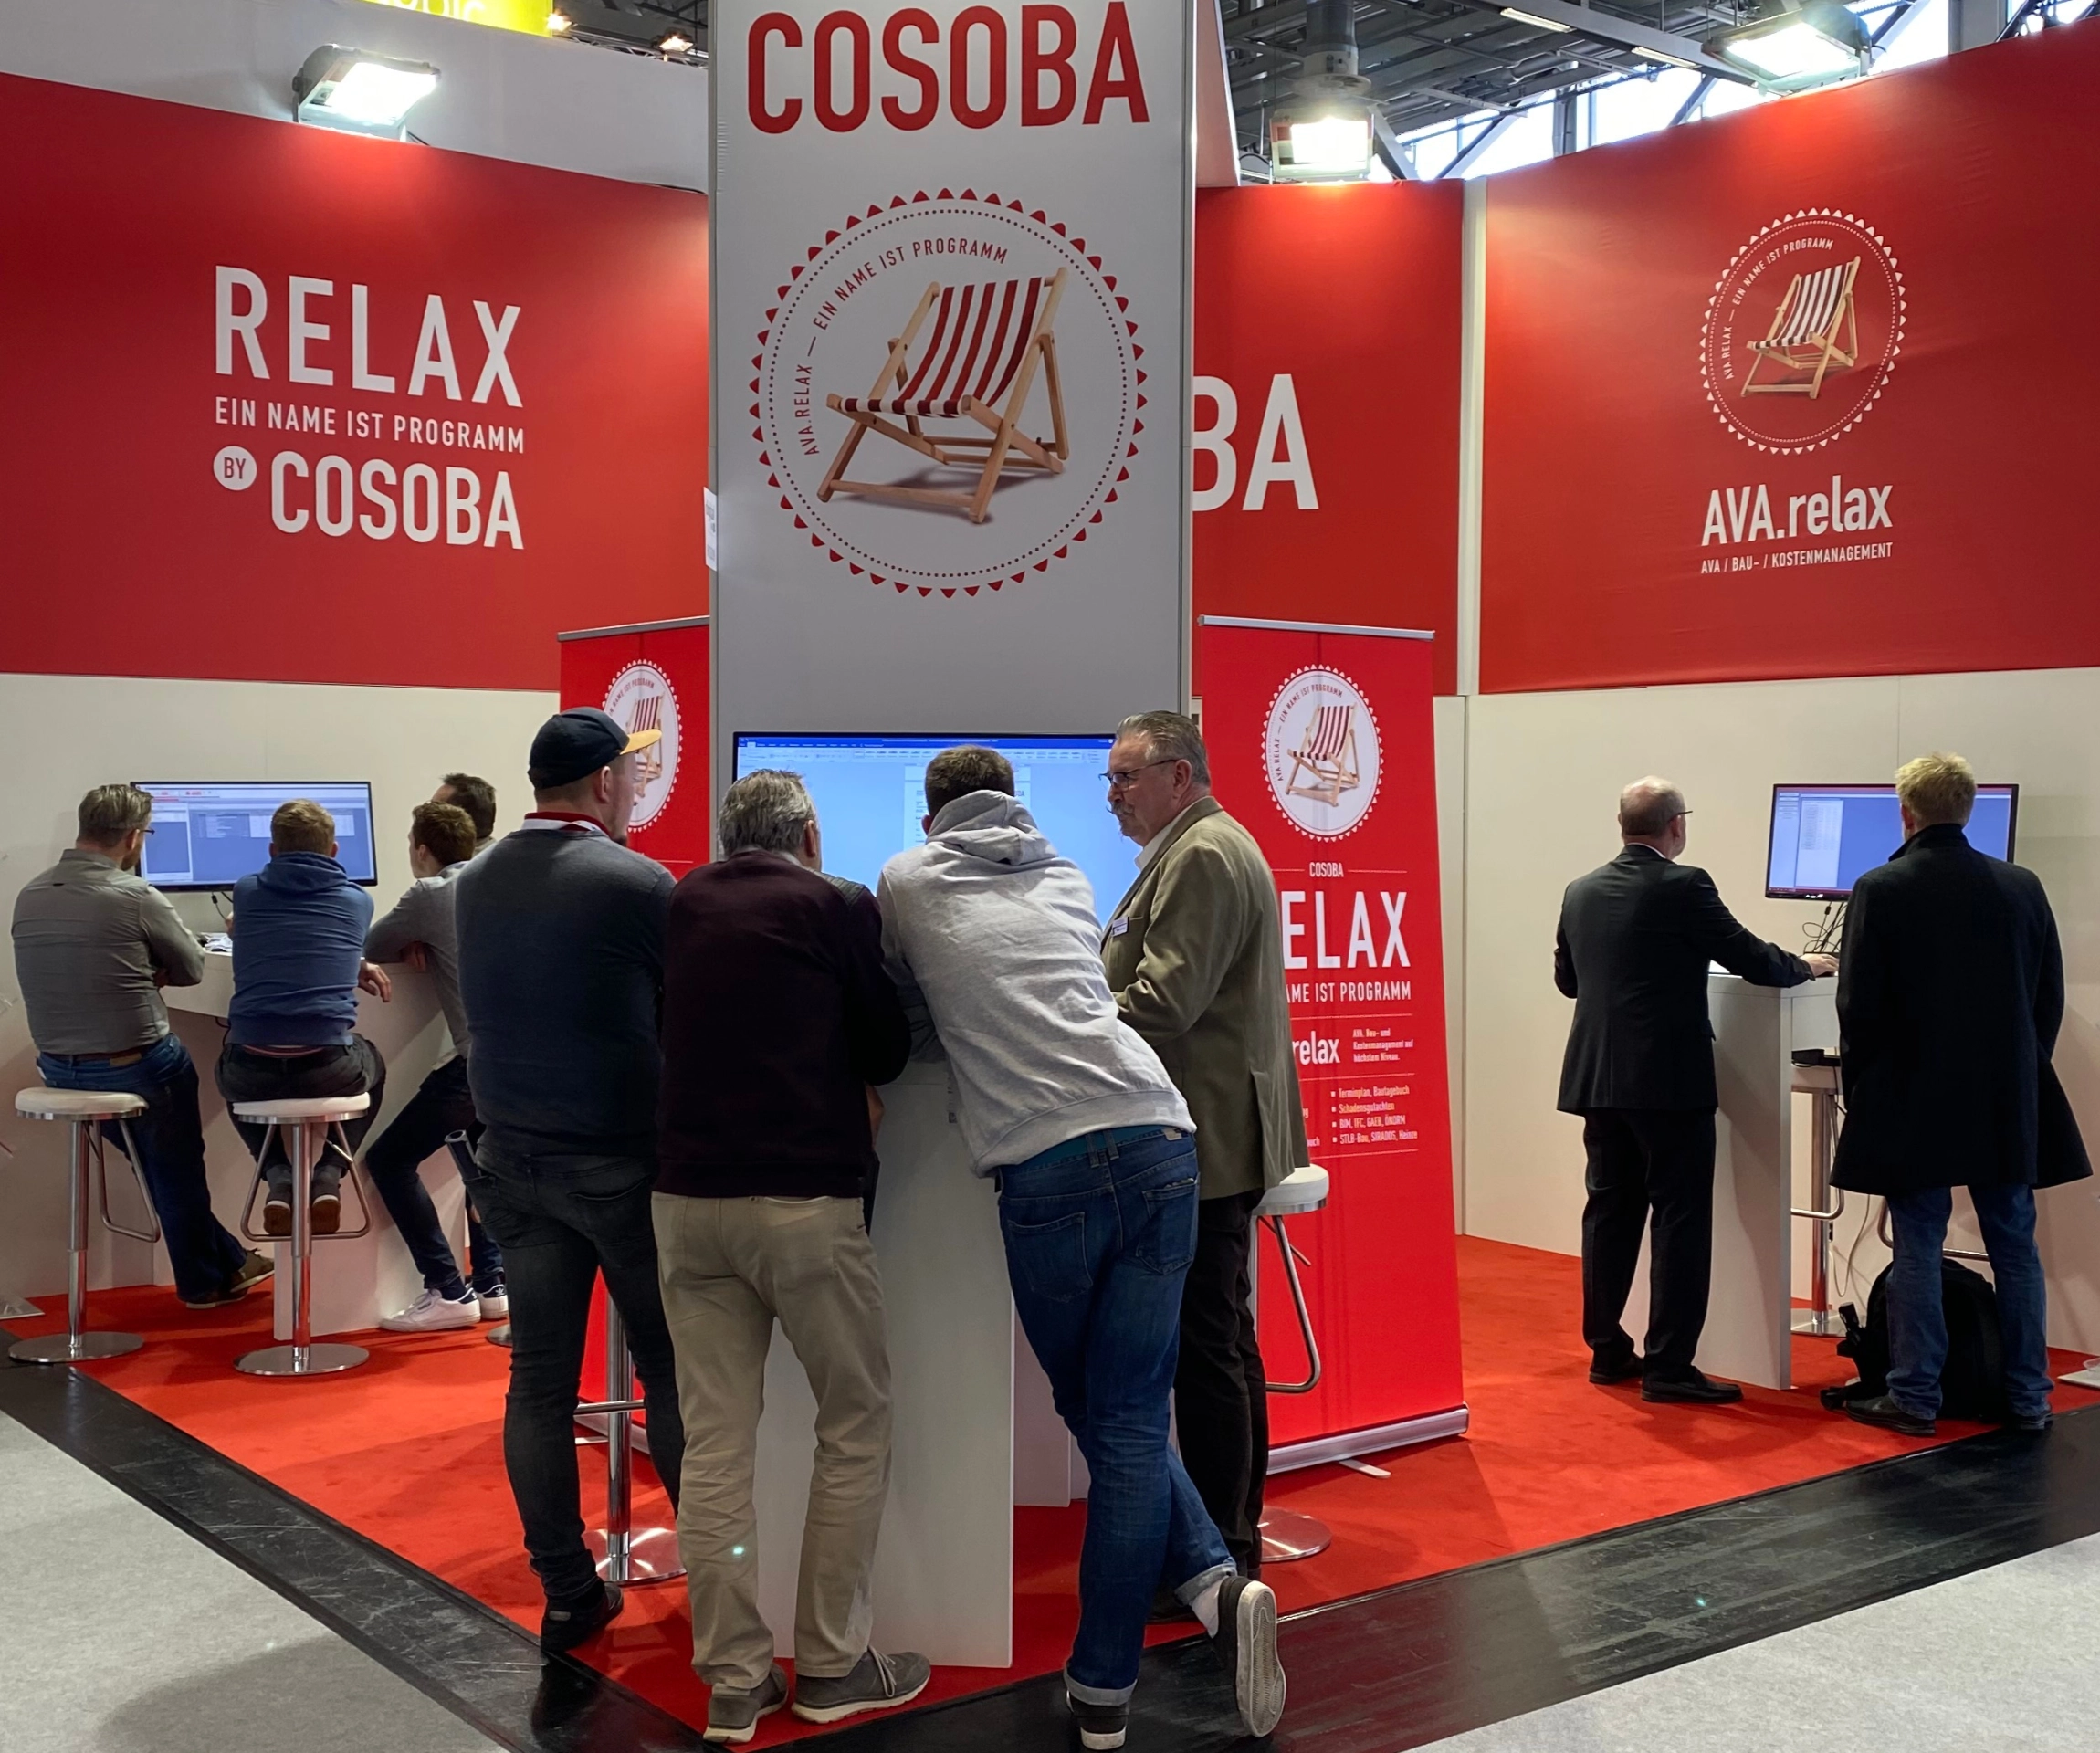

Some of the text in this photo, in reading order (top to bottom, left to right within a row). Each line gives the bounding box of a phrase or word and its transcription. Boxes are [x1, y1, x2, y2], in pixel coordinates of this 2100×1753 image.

[748, 1, 1150, 134] COSOBA
[1732, 287, 1747, 306] EIN
[1743, 259, 1767, 287] NAME
[1766, 247, 1781, 265] IST
[1783, 237, 1834, 255] PROGRAMM
[215, 265, 523, 408] RELAX
[794, 364, 820, 456] AVA.RELAX
[813, 301, 838, 331] EIN
[834, 261, 877, 301] NAME
[878, 246, 907, 269] IST
[913, 237, 1008, 265] PROGRAMM
[215, 396, 524, 454] EIN NAME IST PROGRAMM
[224, 450, 524, 550] BY COSOBA
[1701, 474, 1893, 547] AVA.relax
[1701, 559, 1721, 574] AVA
[1732, 556, 1760, 572] BAU-
[1771, 541, 1894, 568] KOSTENMANAGEMENT
[1278, 709, 1288, 723] EIN
[1286, 691, 1301, 709] NAME
[1300, 685, 1310, 697] IST
[1311, 683, 1343, 698] PROGRAMM
[1309, 861, 1344, 877] COSOBA
[1315, 982, 1335, 1002] IST
[1339, 981, 1412, 1002] PROGRAMM
[1372, 1085, 1410, 1097] Bautagebuch
[1353, 1118, 1366, 1128] IFC,
[1366, 1116, 1384, 1128] GAEB,
